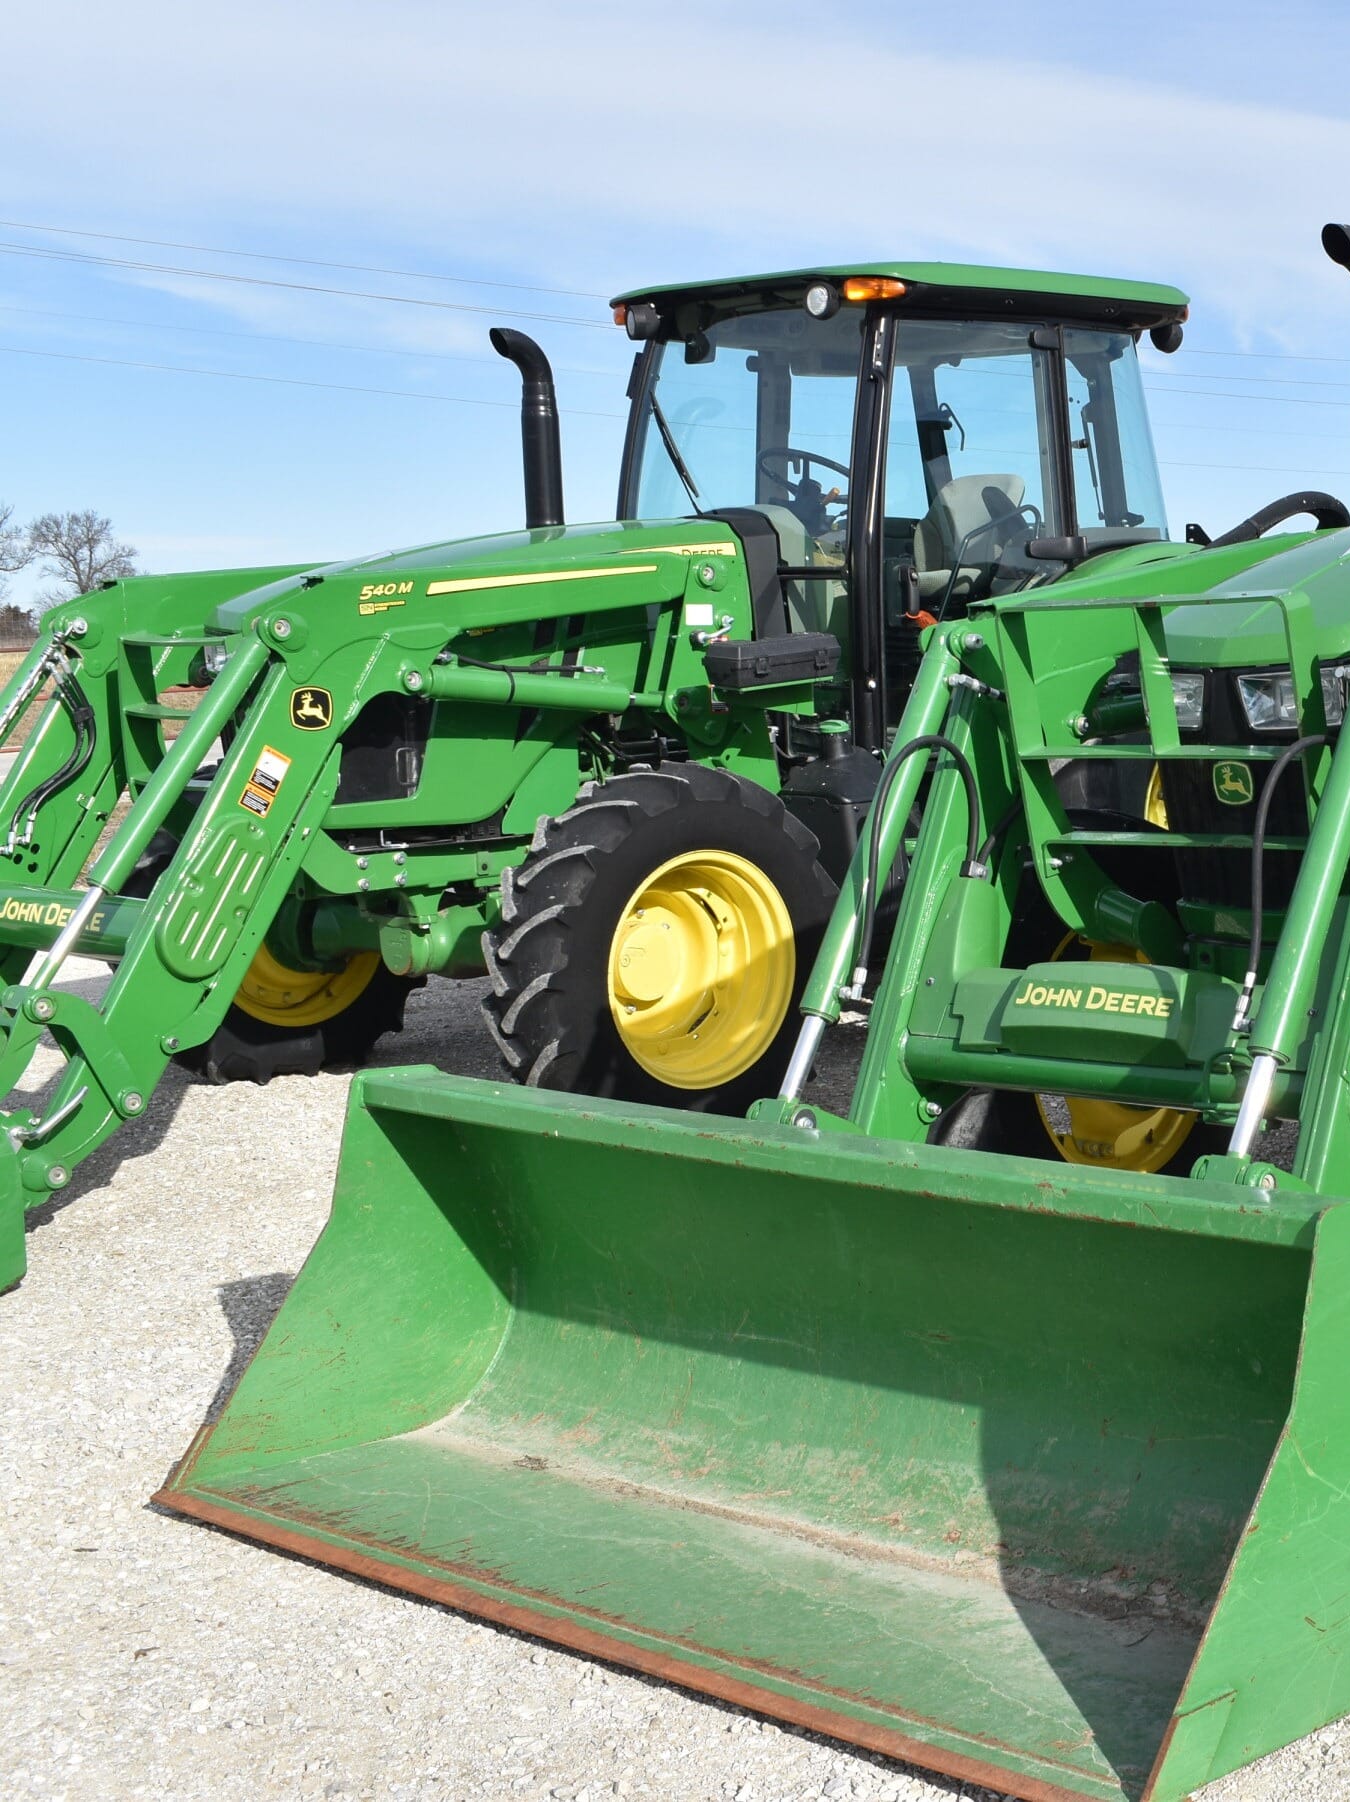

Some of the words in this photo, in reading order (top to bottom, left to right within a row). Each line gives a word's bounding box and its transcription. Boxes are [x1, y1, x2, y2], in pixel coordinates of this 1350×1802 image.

[359, 583, 397, 600] 540
[397, 581, 414, 594] M
[0, 897, 44, 924] JOHN
[44, 903, 105, 932] DEE
[1015, 983, 1083, 1009] JOHN
[1085, 986, 1174, 1017] DEERE
